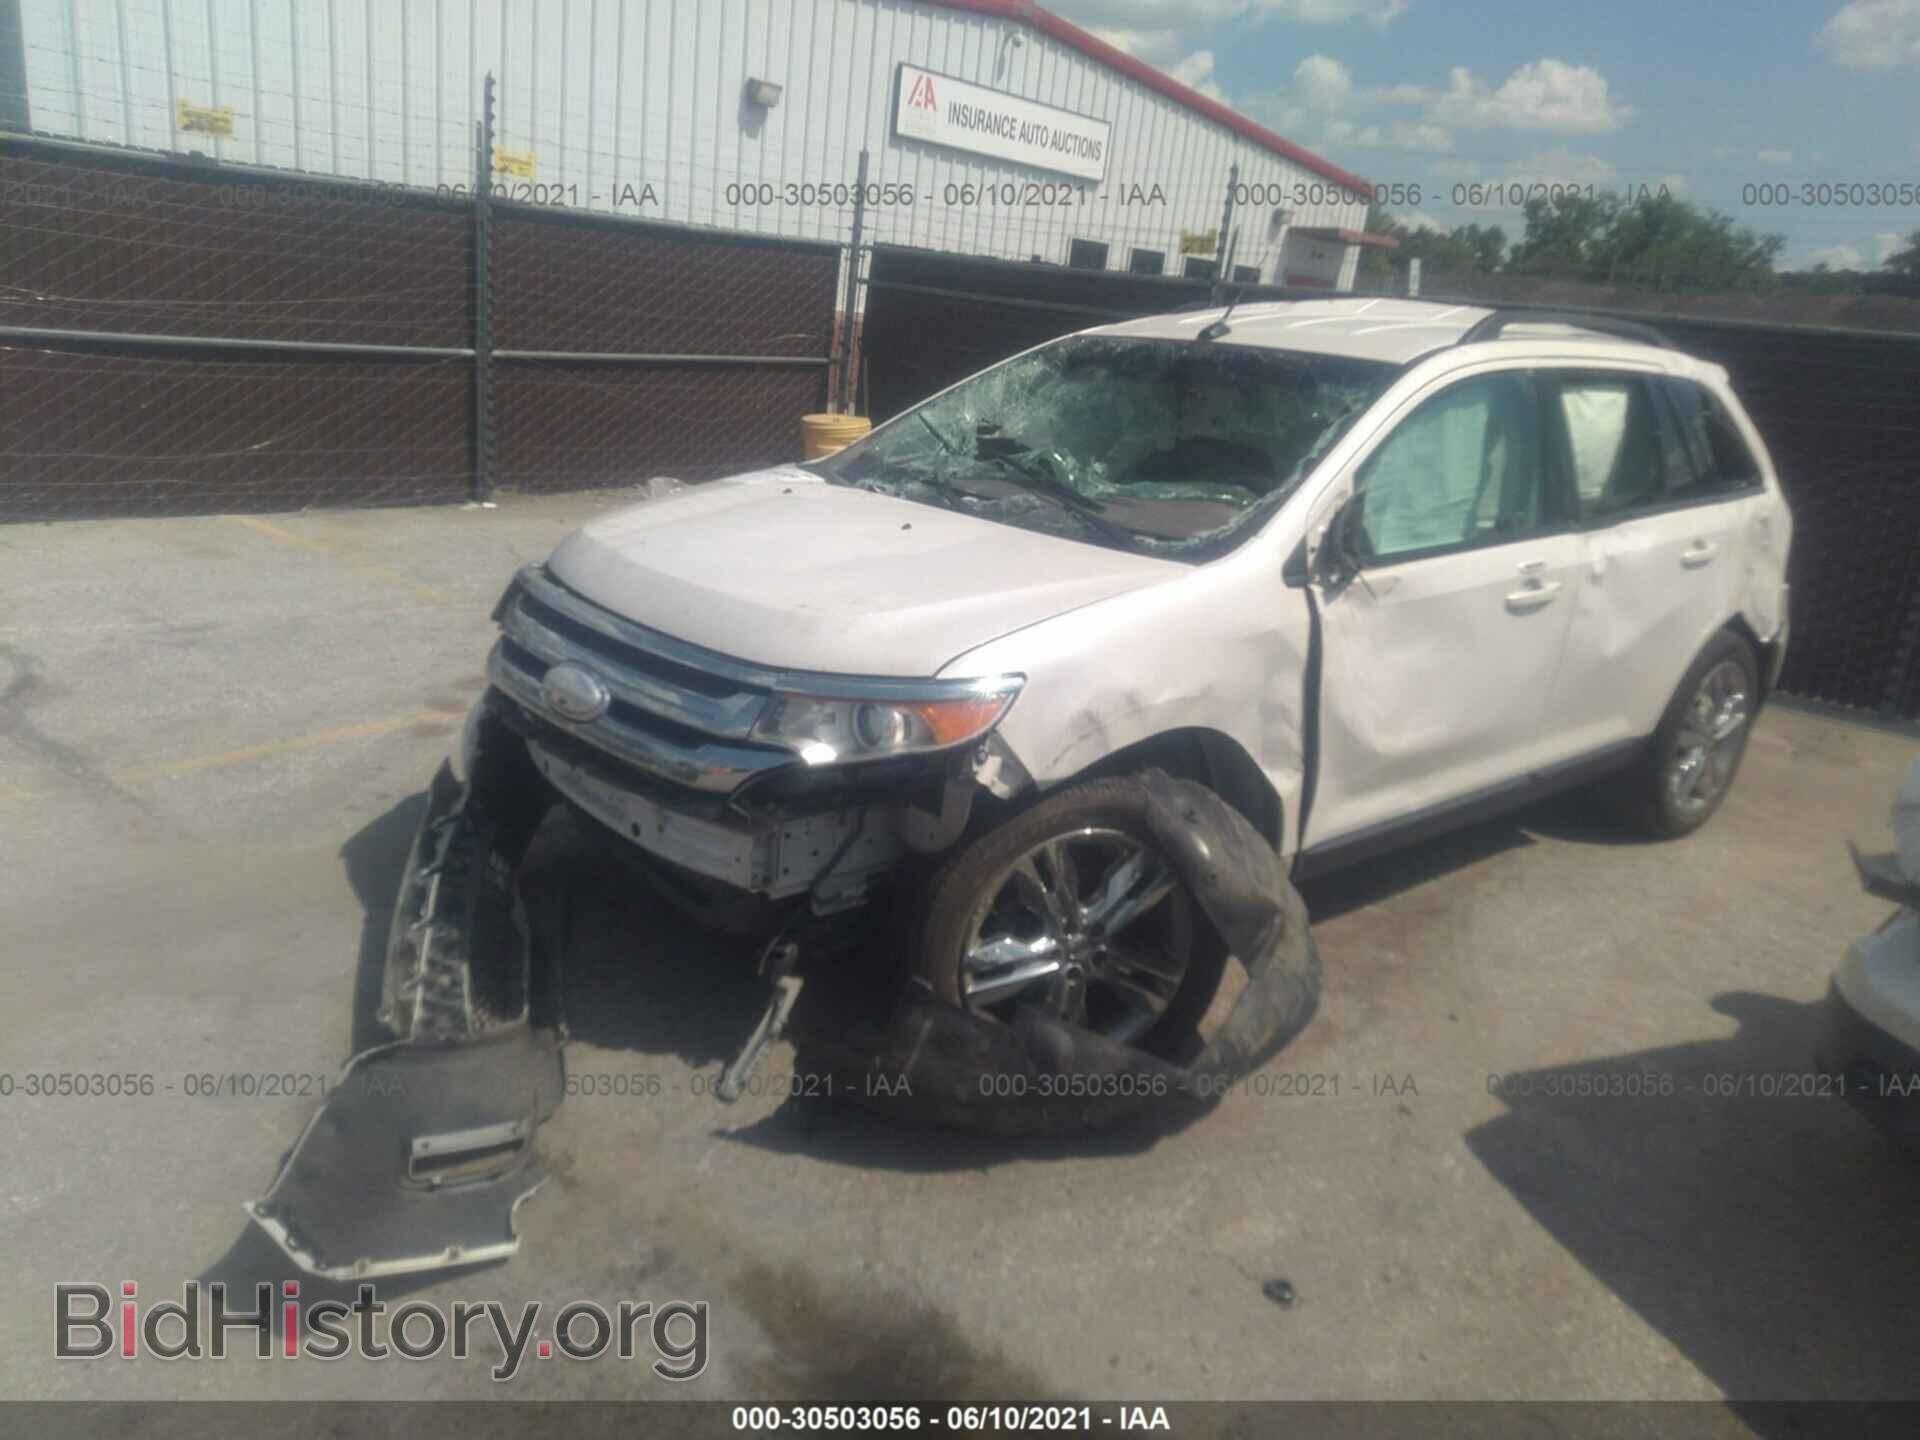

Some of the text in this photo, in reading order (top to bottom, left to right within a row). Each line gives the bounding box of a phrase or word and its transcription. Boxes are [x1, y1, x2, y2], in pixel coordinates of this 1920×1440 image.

[947, 101, 1102, 161] INSURANCE AUTO AUCTIONS
